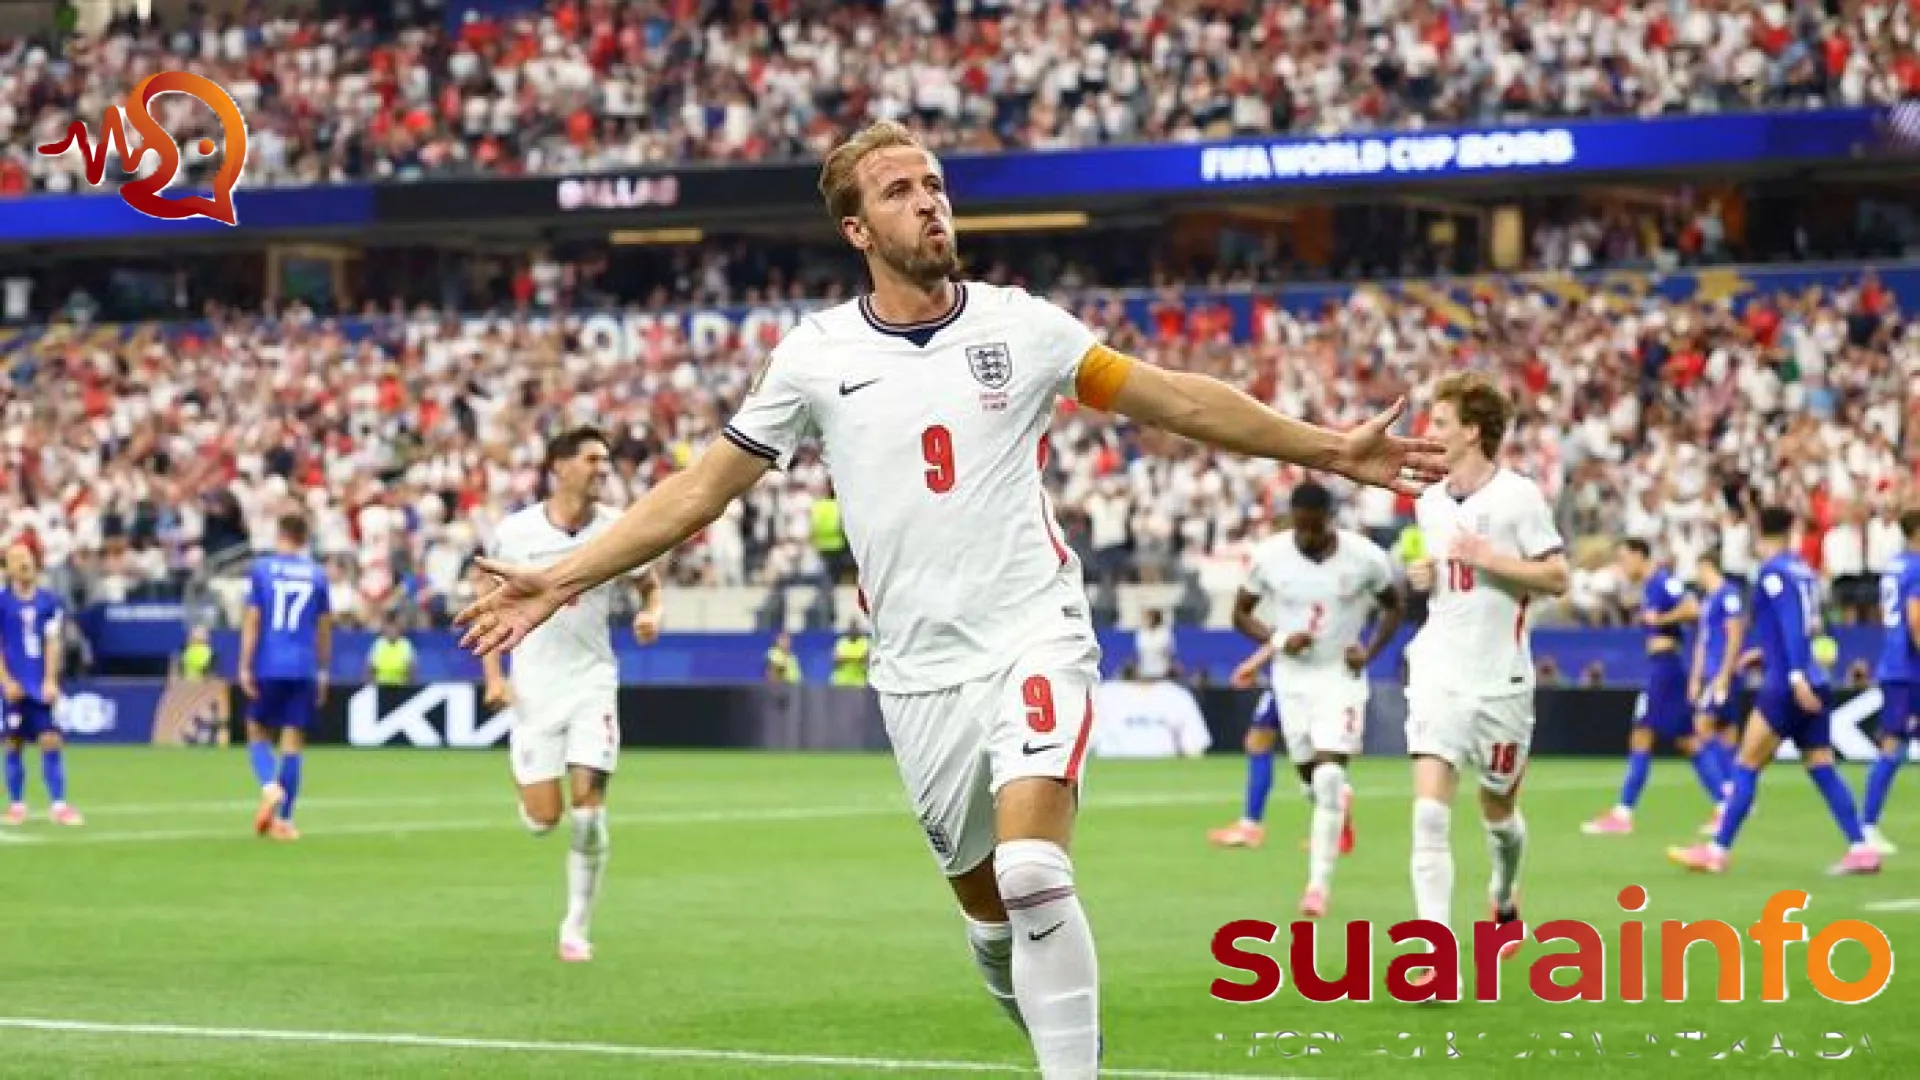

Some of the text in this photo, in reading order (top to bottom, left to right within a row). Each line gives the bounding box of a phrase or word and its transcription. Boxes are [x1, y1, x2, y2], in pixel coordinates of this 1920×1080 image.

[1201, 147, 1271, 181] FIFA
[1271, 139, 1386, 177] WORLD
[1388, 134, 1455, 172] CUP
[921, 424, 955, 493] 9
[272, 580, 313, 632] 17
[1021, 675, 1056, 733] 9
